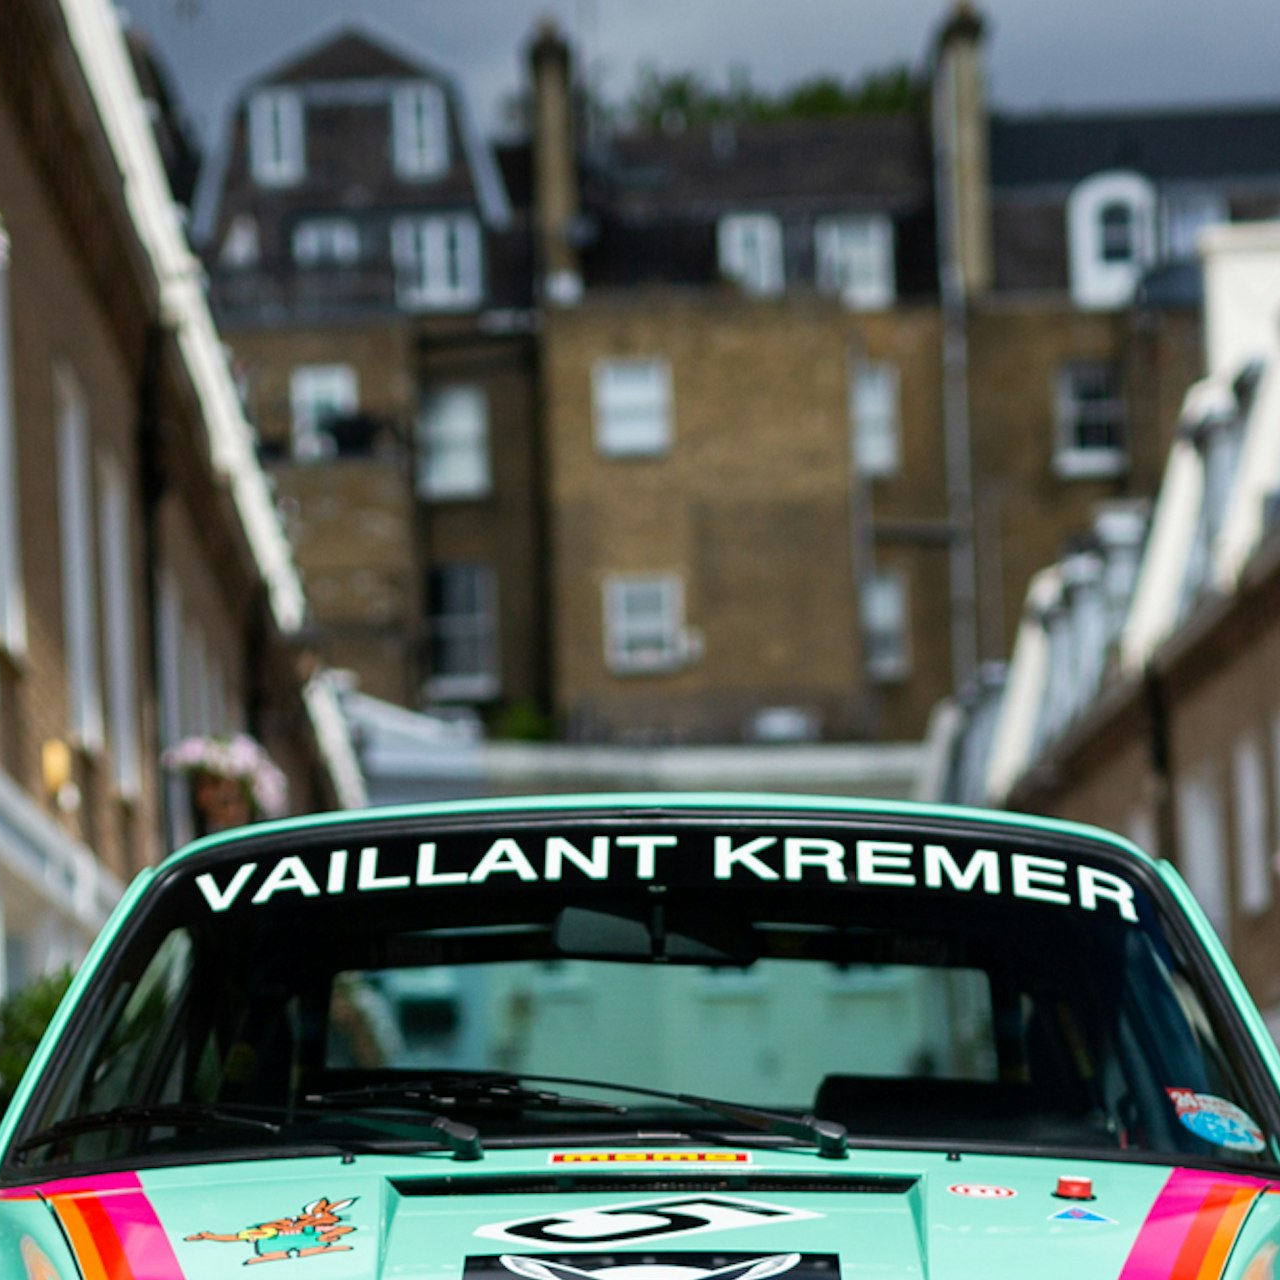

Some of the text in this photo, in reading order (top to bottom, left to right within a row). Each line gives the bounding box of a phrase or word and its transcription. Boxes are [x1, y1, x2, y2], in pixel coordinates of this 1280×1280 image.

[195, 834, 1139, 921] VAILLANT KREMER
[504, 1198, 793, 1243] 5
